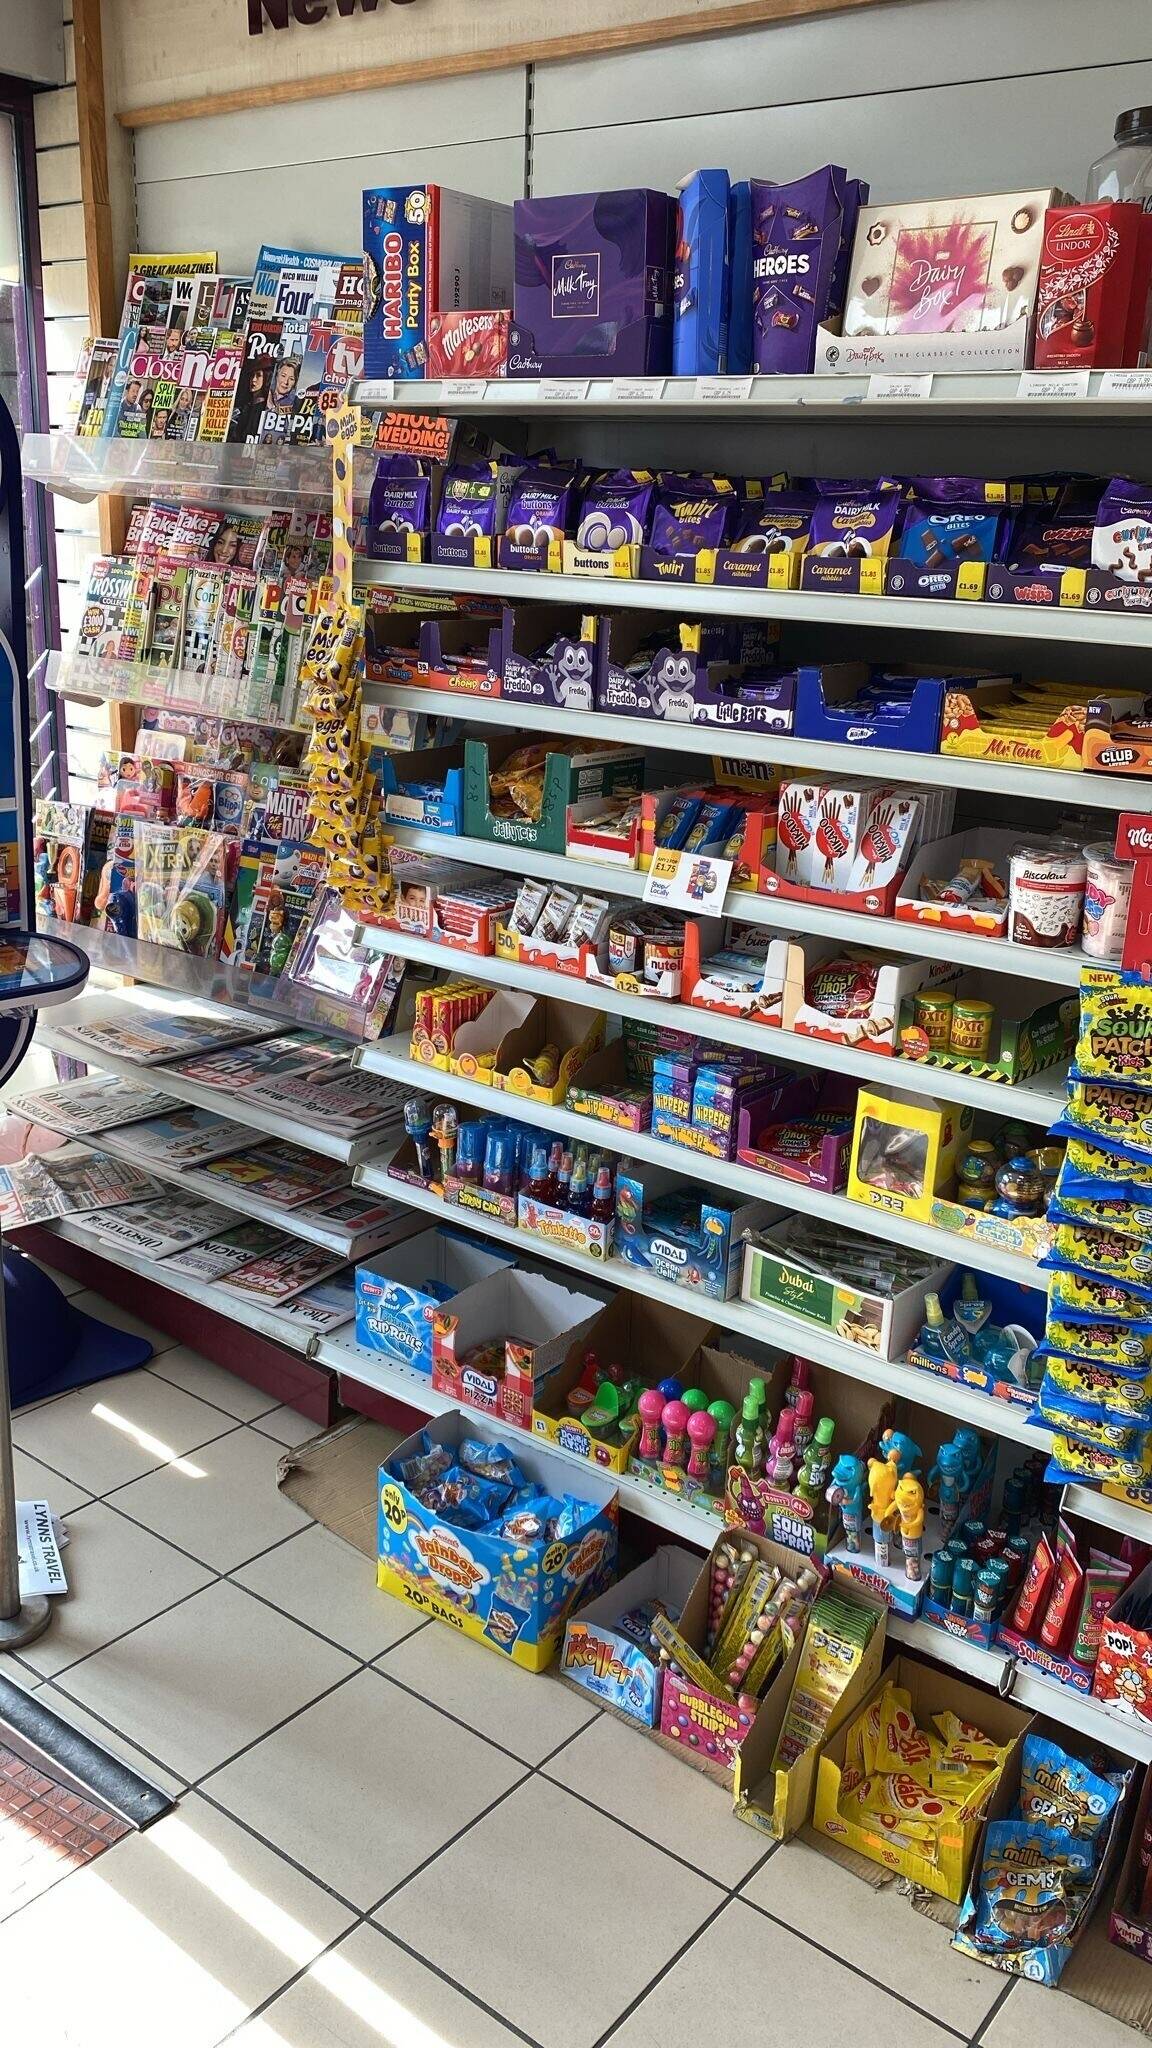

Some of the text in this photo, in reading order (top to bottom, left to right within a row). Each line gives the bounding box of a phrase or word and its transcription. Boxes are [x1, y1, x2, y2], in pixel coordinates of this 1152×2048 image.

[1056, 222, 1084, 239] Lindt
[1055, 239, 1091, 251] LINDOR
[166, 262, 214, 274] MAGAZINES
[754, 254, 810, 279] HEROES
[909, 260, 967, 289] Dairy
[383, 232, 402, 340] HARIBO
[406, 241, 422, 328] Party Box
[553, 271, 598, 299] Milk Tray
[276, 284, 314, 316] Four
[911, 285, 955, 320] Box
[285, 322, 308, 332] Total
[441, 313, 495, 360] Maltesers
[913, 349, 955, 358] CLASSIC
[958, 348, 1021, 356] COLLECTION
[509, 354, 543, 372] Cadbury
[378, 426, 450, 448] WEDDING!
[520, 492, 560, 501] DAIRY MILK
[521, 500, 552, 510] buttons
[670, 499, 716, 518] Twirl
[834, 502, 880, 516] DAIRY MILK
[180, 510, 220, 534] Take a
[928, 514, 986, 526] OREO
[946, 521, 970, 530] BITES
[172, 528, 214, 548] Break
[373, 544, 402, 554] buttons
[438, 546, 468, 558] buttons
[510, 544, 539, 555] buttons
[574, 558, 610, 570] buttons
[654, 560, 684, 576] Twirl
[723, 560, 762, 572] Caramel
[812, 564, 853, 576] Caramel
[194, 569, 219, 580] Puzzler
[918, 574, 952, 587] OREO
[958, 583, 978, 592] £1.69
[1014, 586, 1052, 602] Wispa
[1060, 592, 1080, 602] £1.69
[504, 678, 532, 692] Freddo
[568, 687, 587, 697] Freddo
[607, 690, 636, 705] Freddo
[668, 698, 688, 709] Freddo
[716, 702, 767, 722] Little Bars
[1102, 750, 1134, 763] CLUB
[282, 817, 309, 842] DAY
[493, 822, 538, 842] Jelly Tots
[782, 810, 810, 851] MIKADO
[820, 818, 848, 858] MIKADO
[868, 824, 892, 864] MIKADO
[655, 864, 677, 874] £1.75
[650, 887, 670, 898] Locally
[651, 880, 664, 890] Shop
[1088, 973, 1114, 984] NEW
[616, 981, 639, 994] £1.25
[818, 982, 847, 994] DROP
[952, 1018, 984, 1033] TOXIC
[951, 1033, 982, 1048] WASTE
[1118, 1056, 1144, 1068] Kids
[1109, 1106, 1134, 1121] Kids
[868, 1190, 906, 1212] PEZ
[98, 1222, 164, 1252] Observer
[538, 1220, 586, 1244] Trinketto
[654, 1242, 685, 1262] VIDAL
[1098, 1244, 1124, 1258] Kids
[655, 1258, 681, 1273] Ocean
[658, 1266, 677, 1282] Jelly
[778, 1266, 815, 1294] Dubai
[362, 1284, 382, 1295] BOBBY'S
[1102, 1286, 1126, 1300] Kids
[368, 1318, 424, 1352] RIP ROLLS
[942, 1324, 962, 1343] Candy
[1088, 1330, 1113, 1344] Kids
[946, 1333, 966, 1352] Spray
[910, 1354, 948, 1374] millions
[466, 1372, 494, 1392] VIDAL
[1089, 1373, 1113, 1388] Kids
[464, 1387, 495, 1407] PIZZA
[536, 1420, 545, 1430] £1
[1090, 1452, 1114, 1466] Kids
[384, 1490, 400, 1504] only
[774, 1514, 814, 1542] SOUR
[34, 1504, 62, 1584] LYNNS TRAVEL
[773, 1530, 814, 1554] SPRAY
[415, 1535, 485, 1582] Rainbow
[427, 1555, 473, 1589] Drops
[850, 1564, 890, 1589] Wacky
[431, 1600, 464, 1628] BAGS
[1108, 1636, 1133, 1652] POP!
[566, 1640, 632, 1684] Roller
[1018, 1641, 1071, 1680] SQUEEZE POP
[680, 1693, 739, 1730] BUBBLEGUM
[690, 1711, 726, 1736] STRIPS
[1030, 1796, 1079, 1829] GEMS
[1006, 1870, 1056, 1889] GEMS
[1116, 1928, 1142, 1945] VIMTO
[1028, 1963, 1043, 1979] £1
